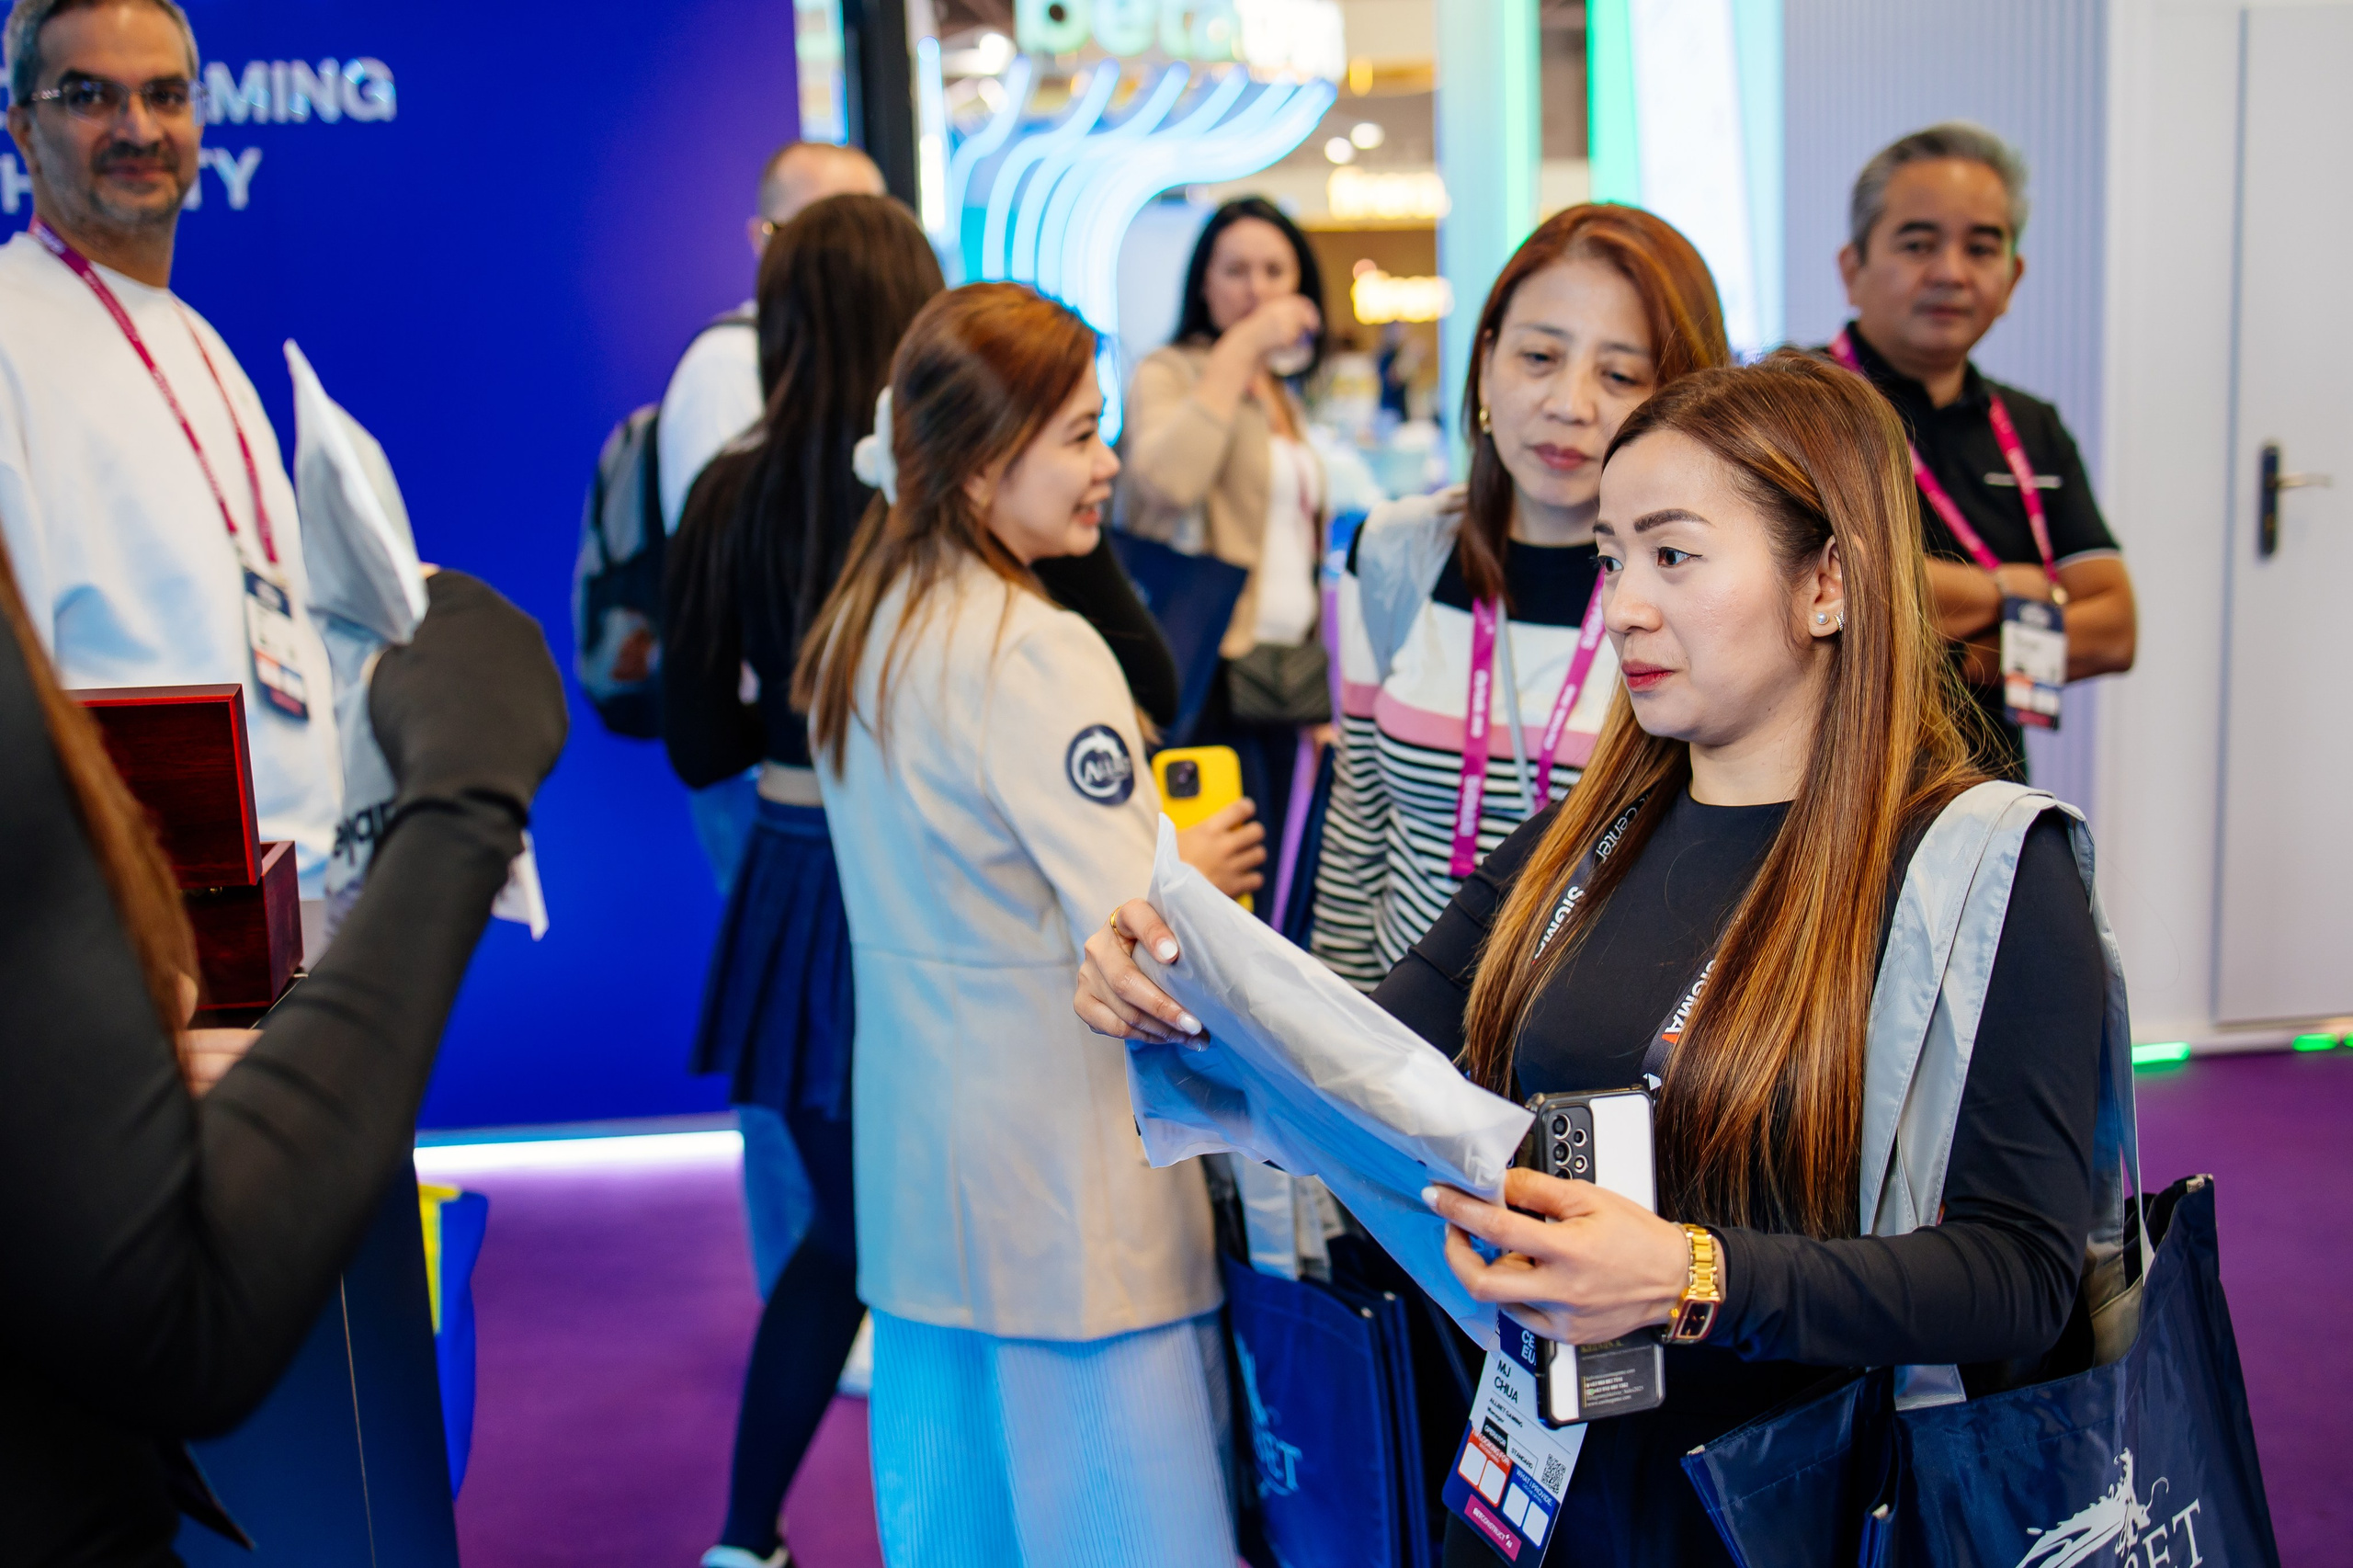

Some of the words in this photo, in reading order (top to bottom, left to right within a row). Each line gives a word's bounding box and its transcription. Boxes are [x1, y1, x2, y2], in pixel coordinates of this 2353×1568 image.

[191, 58, 396, 124] MING
[1497, 1359, 1511, 1378] MJ
[1495, 1377, 1518, 1404] CHUA
[1483, 1424, 1506, 1448] OPERATOR
[1510, 1447, 1533, 1470] STANDARD
